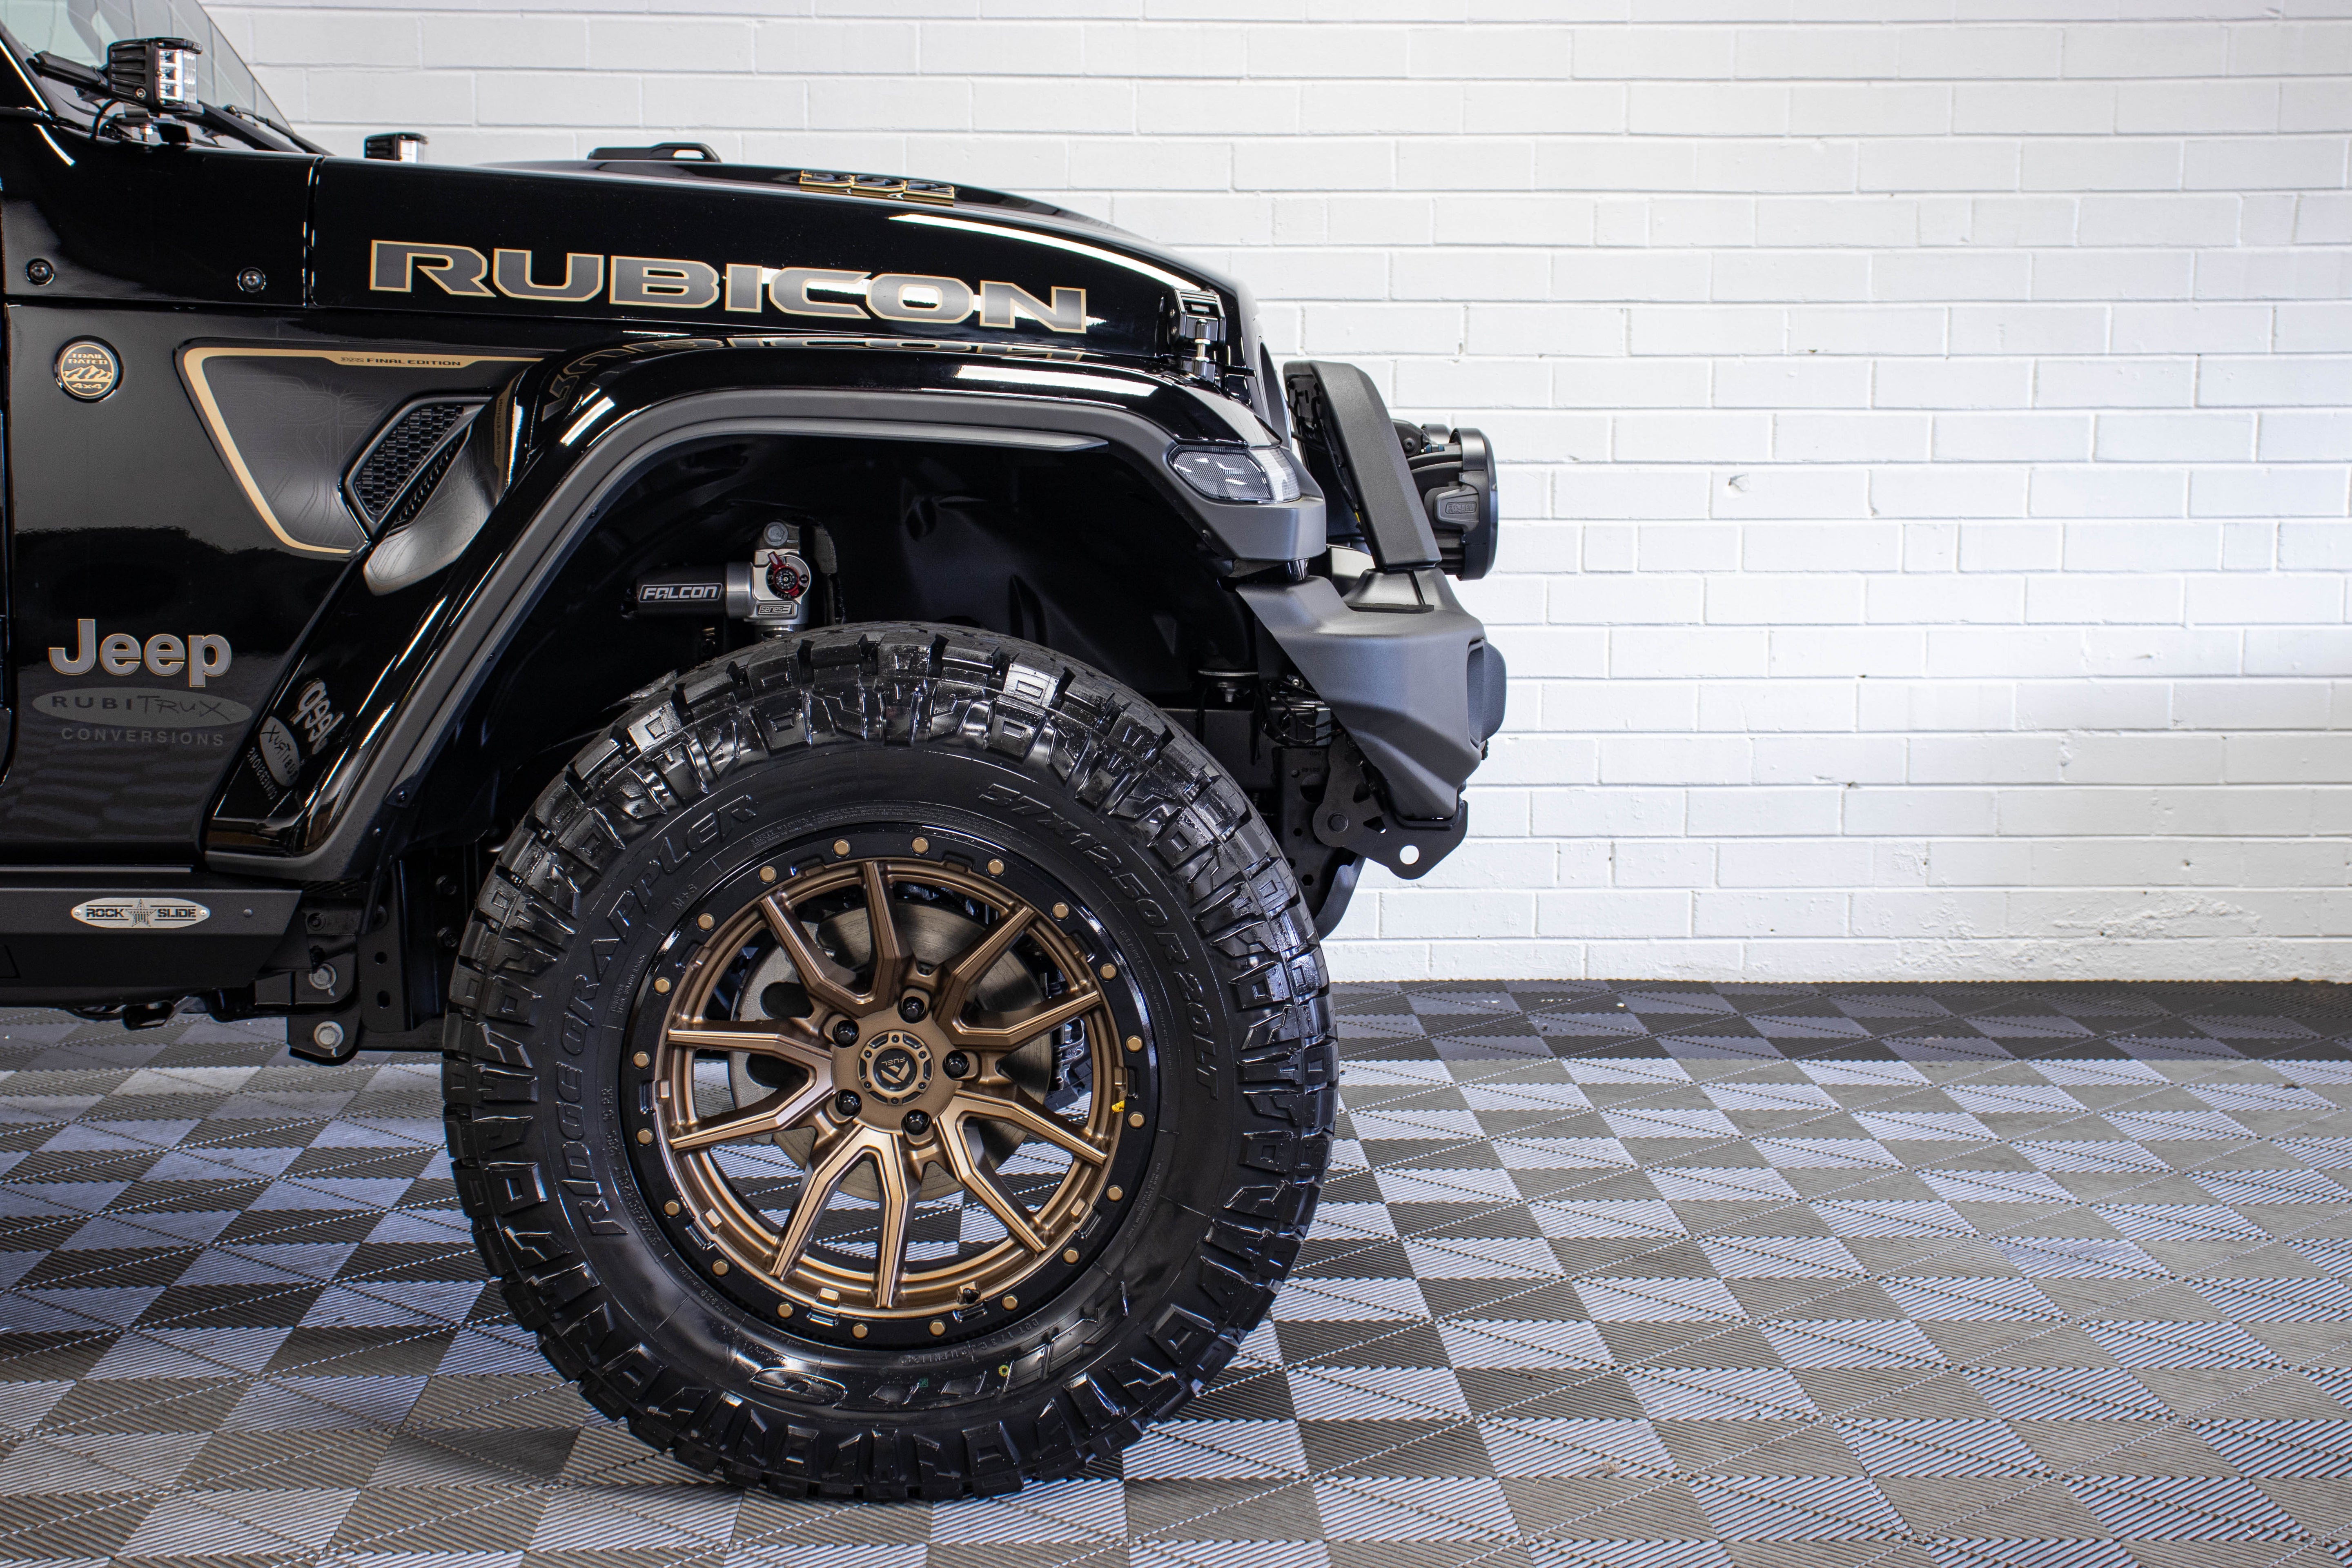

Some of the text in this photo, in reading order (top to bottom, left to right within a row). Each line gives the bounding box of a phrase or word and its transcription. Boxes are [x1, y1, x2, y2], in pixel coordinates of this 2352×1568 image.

[369, 240, 1087, 334] RUBICON
[642, 586, 717, 600] FALCON
[48, 618, 232, 687] Jeep
[61, 727, 224, 746] CONVERSIONS
[86, 908, 196, 918] ROCK SLIDE
[556, 795, 756, 1235] RIDGE GRAPPLER
[881, 1056, 906, 1066] FUEL
